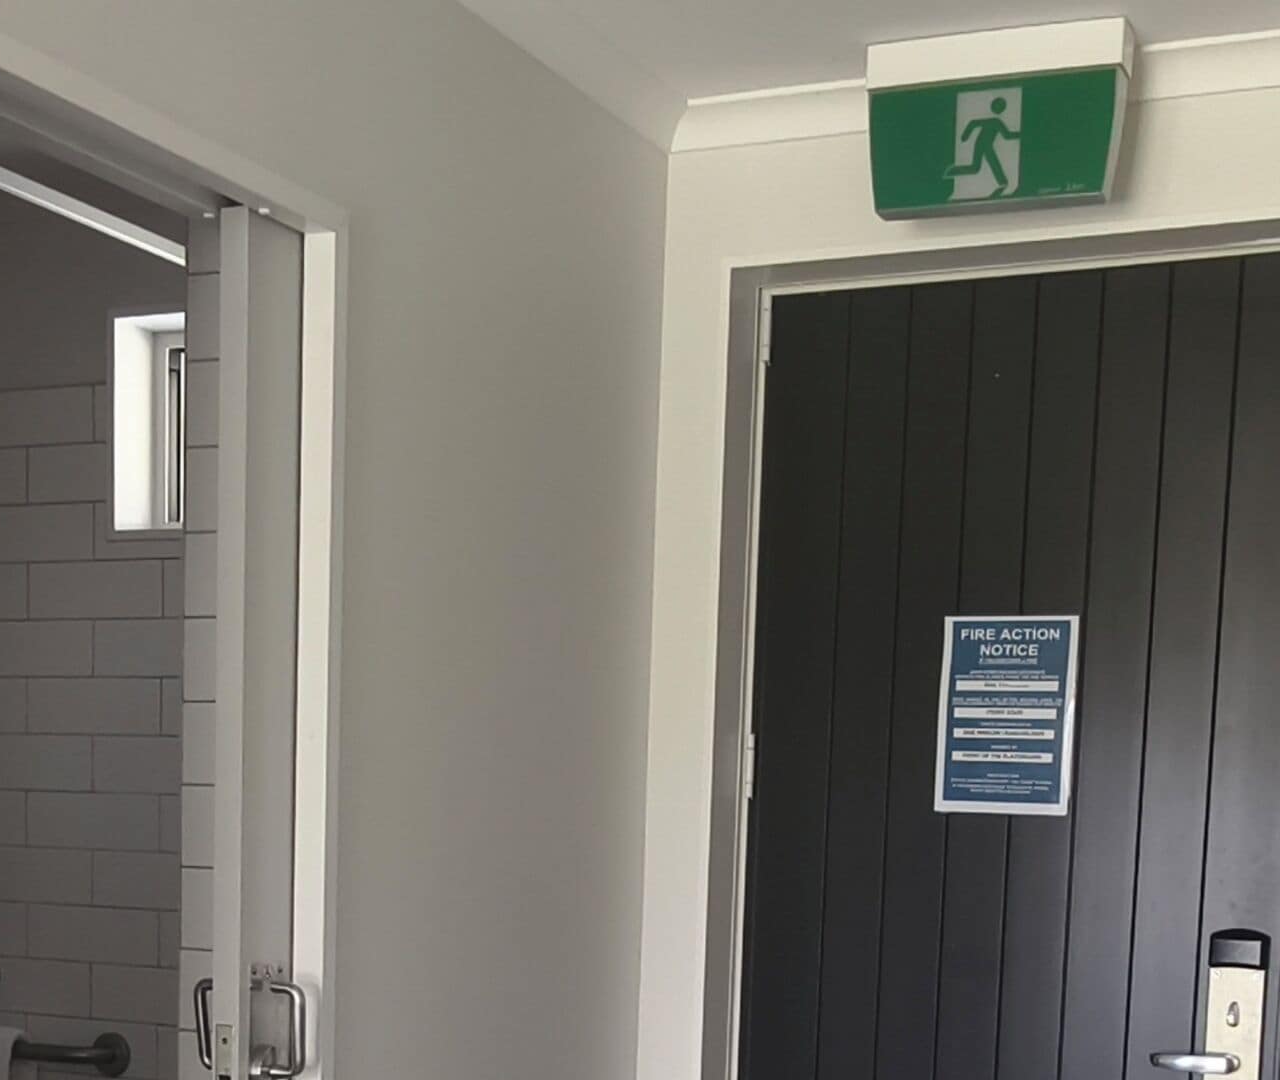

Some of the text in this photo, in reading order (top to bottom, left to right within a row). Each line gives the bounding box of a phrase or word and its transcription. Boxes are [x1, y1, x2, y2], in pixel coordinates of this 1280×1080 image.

[960, 627, 1060, 640] FIRE ACTION
[980, 644, 1039, 656] NOTICE
